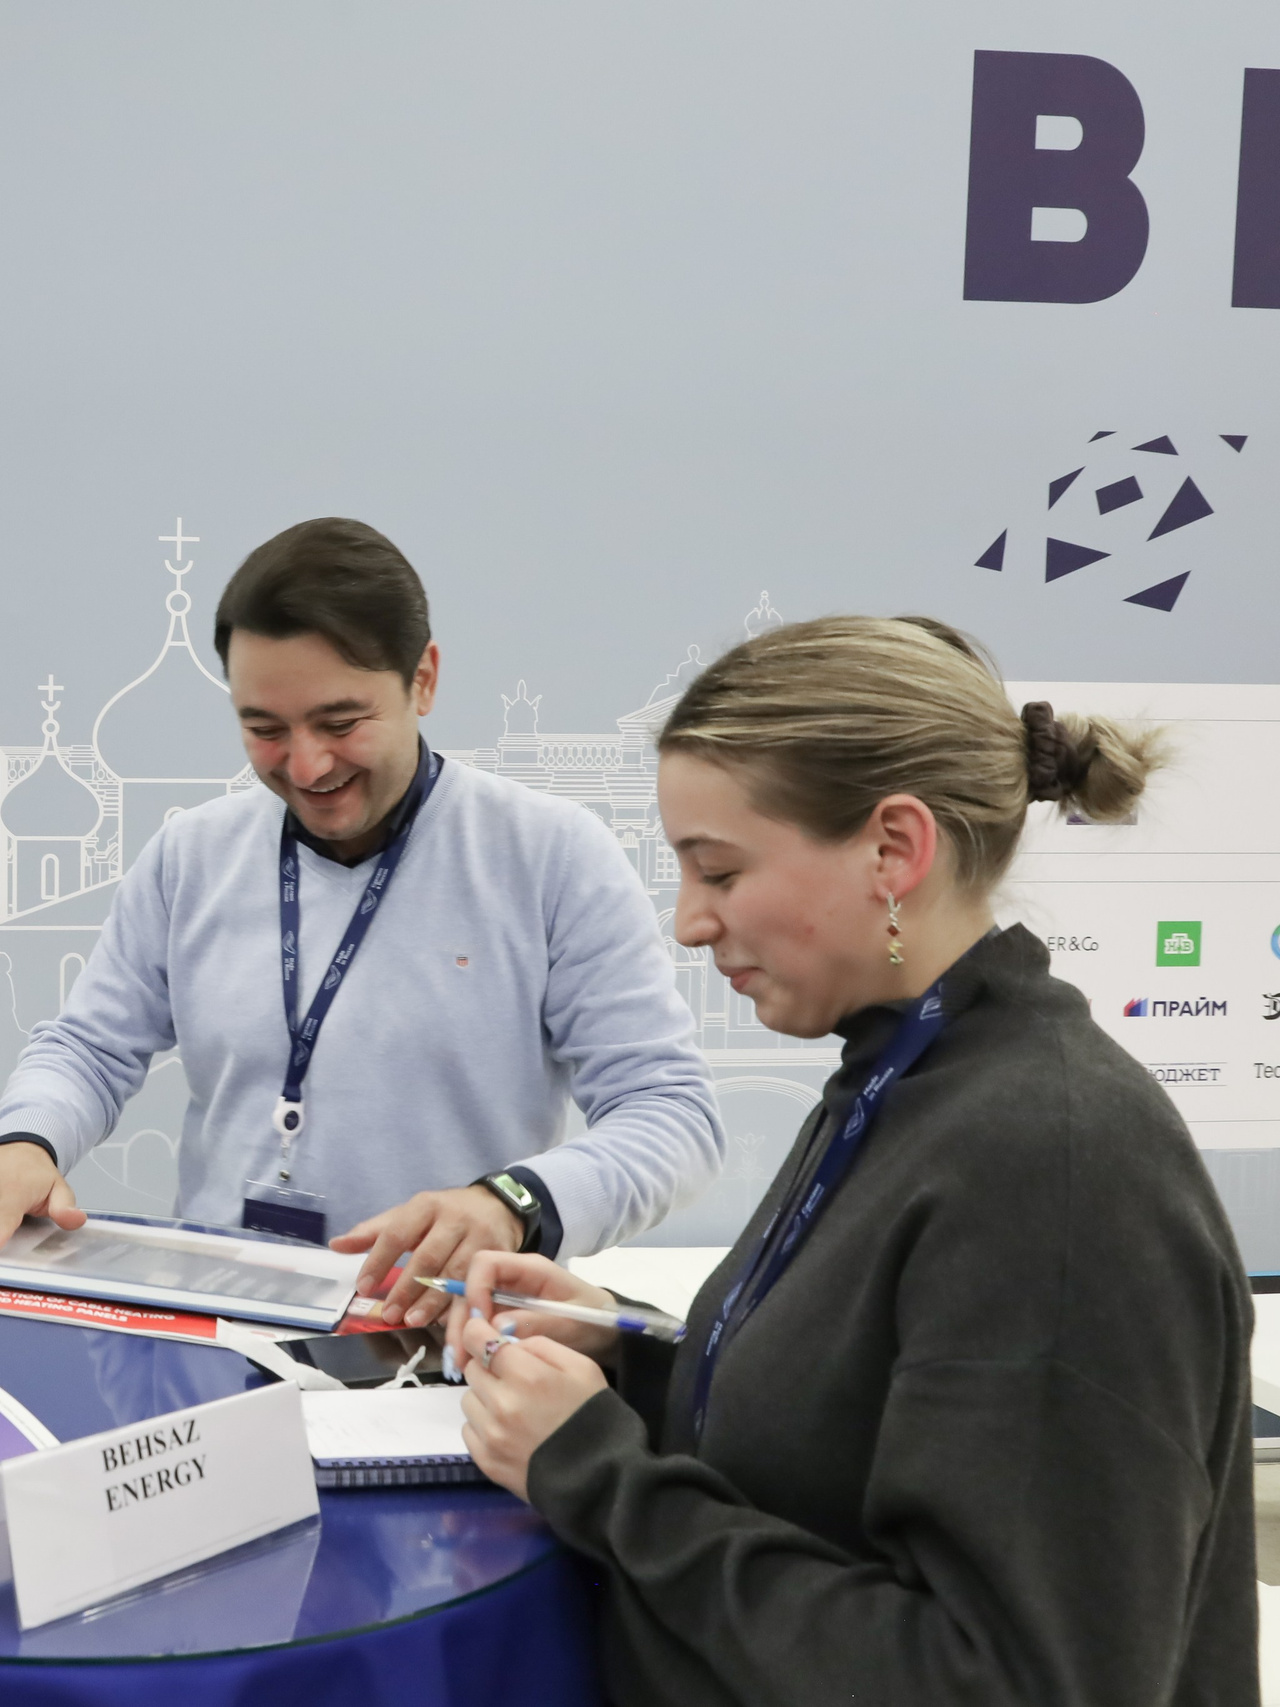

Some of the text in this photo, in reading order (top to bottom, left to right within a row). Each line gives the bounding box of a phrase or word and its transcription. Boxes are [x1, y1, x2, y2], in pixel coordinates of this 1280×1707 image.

[1164, 933, 1195, 955] НТВ
[1152, 996, 1228, 1017] ПРАЙМ
[13, 1297, 75, 1313] HEATING
[75, 1307, 129, 1322] PANELS
[46, 1295, 66, 1305] OF
[67, 1299, 113, 1314] CABLE
[113, 1308, 176, 1321] HEATING
[102, 1418, 202, 1473] BEHSAZ
[105, 1453, 207, 1513] ENERGY
